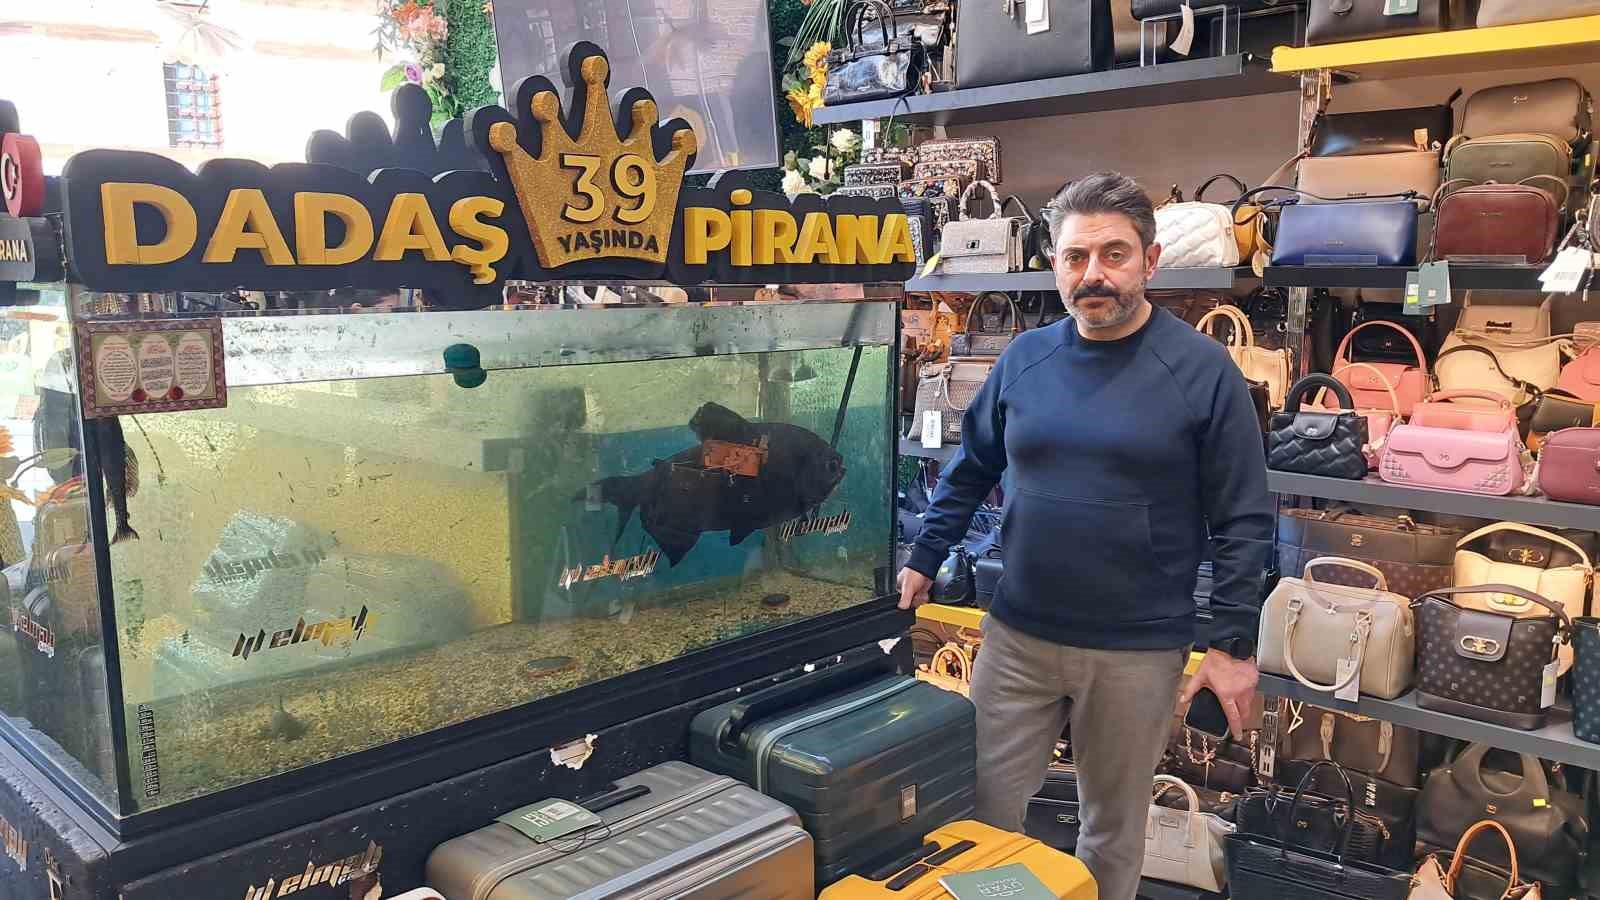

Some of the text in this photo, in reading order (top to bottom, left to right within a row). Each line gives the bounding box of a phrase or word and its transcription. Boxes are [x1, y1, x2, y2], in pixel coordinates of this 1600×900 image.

[559, 153, 657, 224] 39
[101, 182, 915, 284] DADAŞ PİRANA
[557, 230, 660, 254] YAŞINDA
